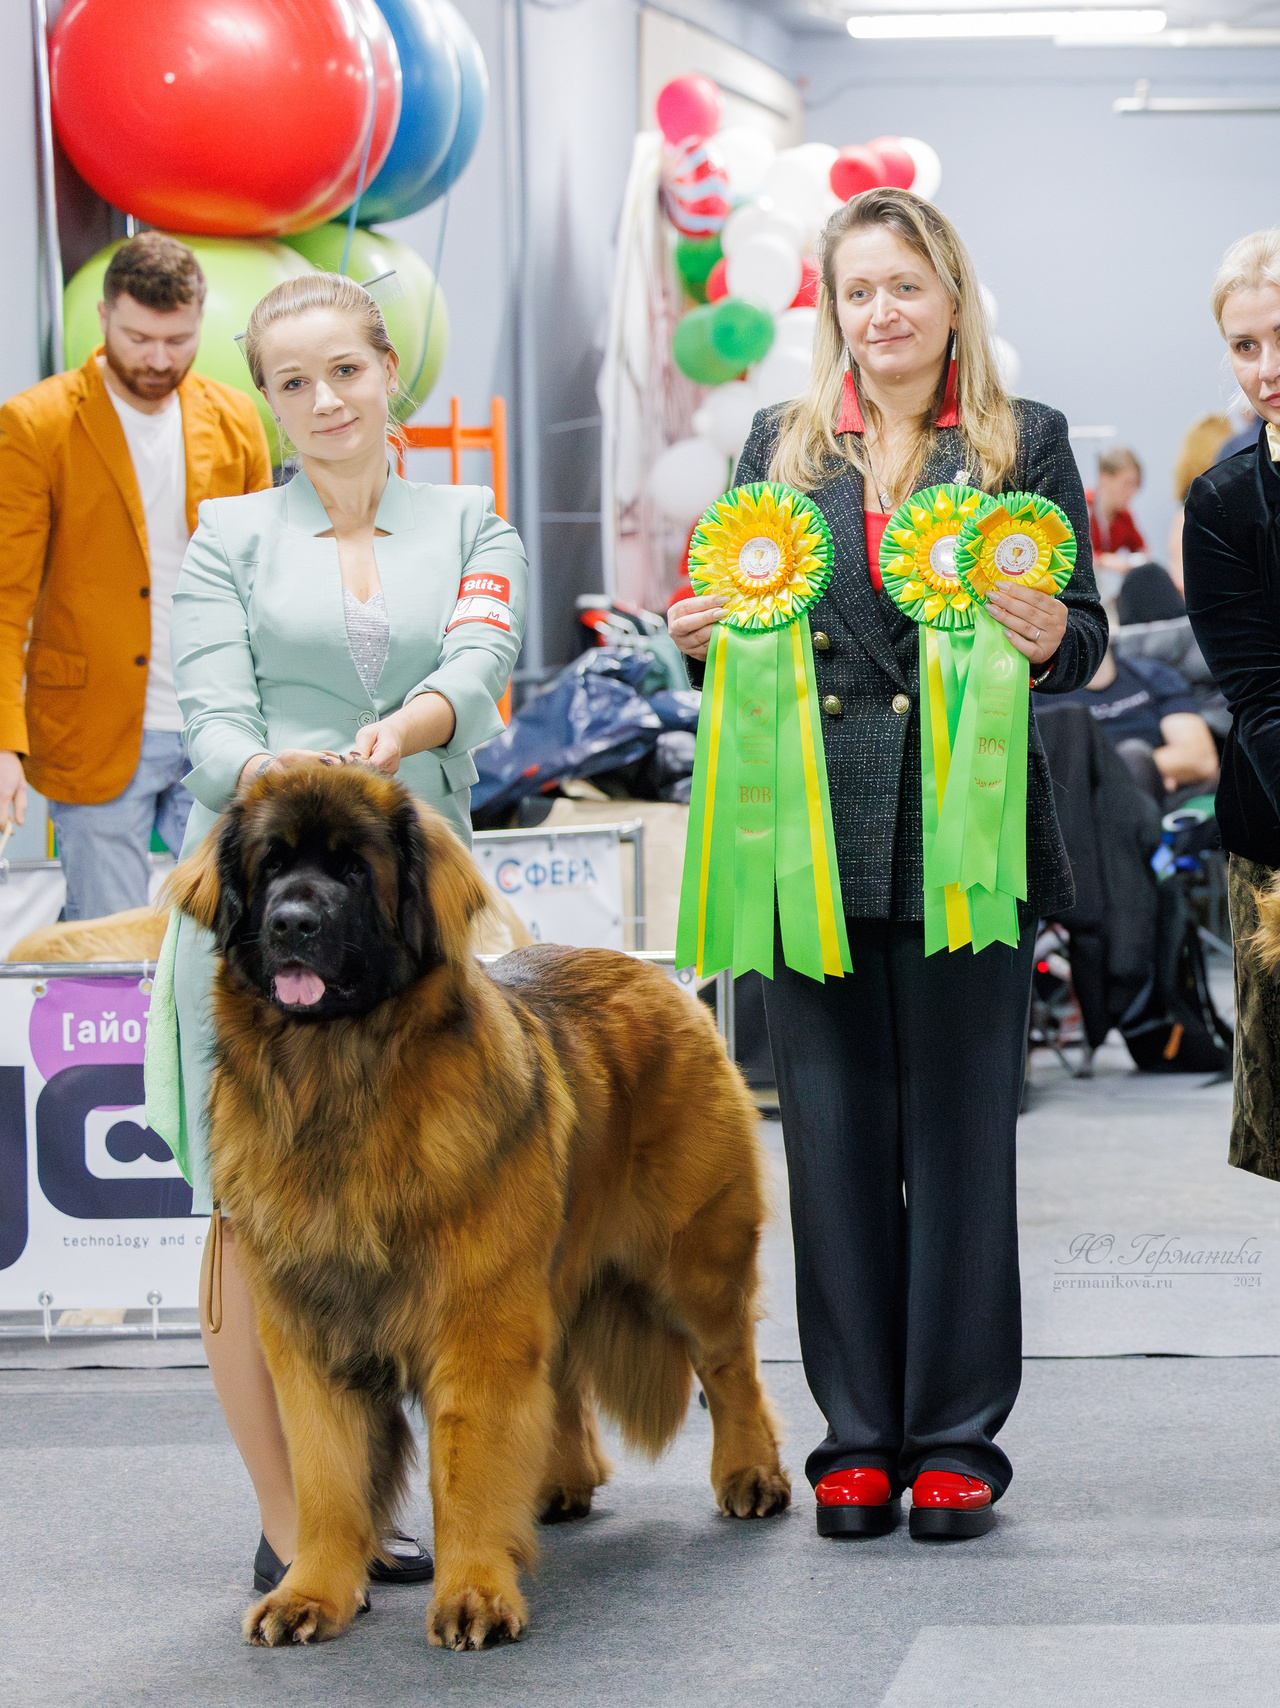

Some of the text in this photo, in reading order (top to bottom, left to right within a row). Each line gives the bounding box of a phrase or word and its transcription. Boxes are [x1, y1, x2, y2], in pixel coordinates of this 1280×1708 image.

[463, 578, 504, 593] Blitz
[978, 737, 1006, 756] BOS
[739, 786, 771, 803] BOB
[495, 857, 598, 894] СФЕРА
[63, 1234, 149, 1249] technology
[160, 1234, 185, 1245] and
